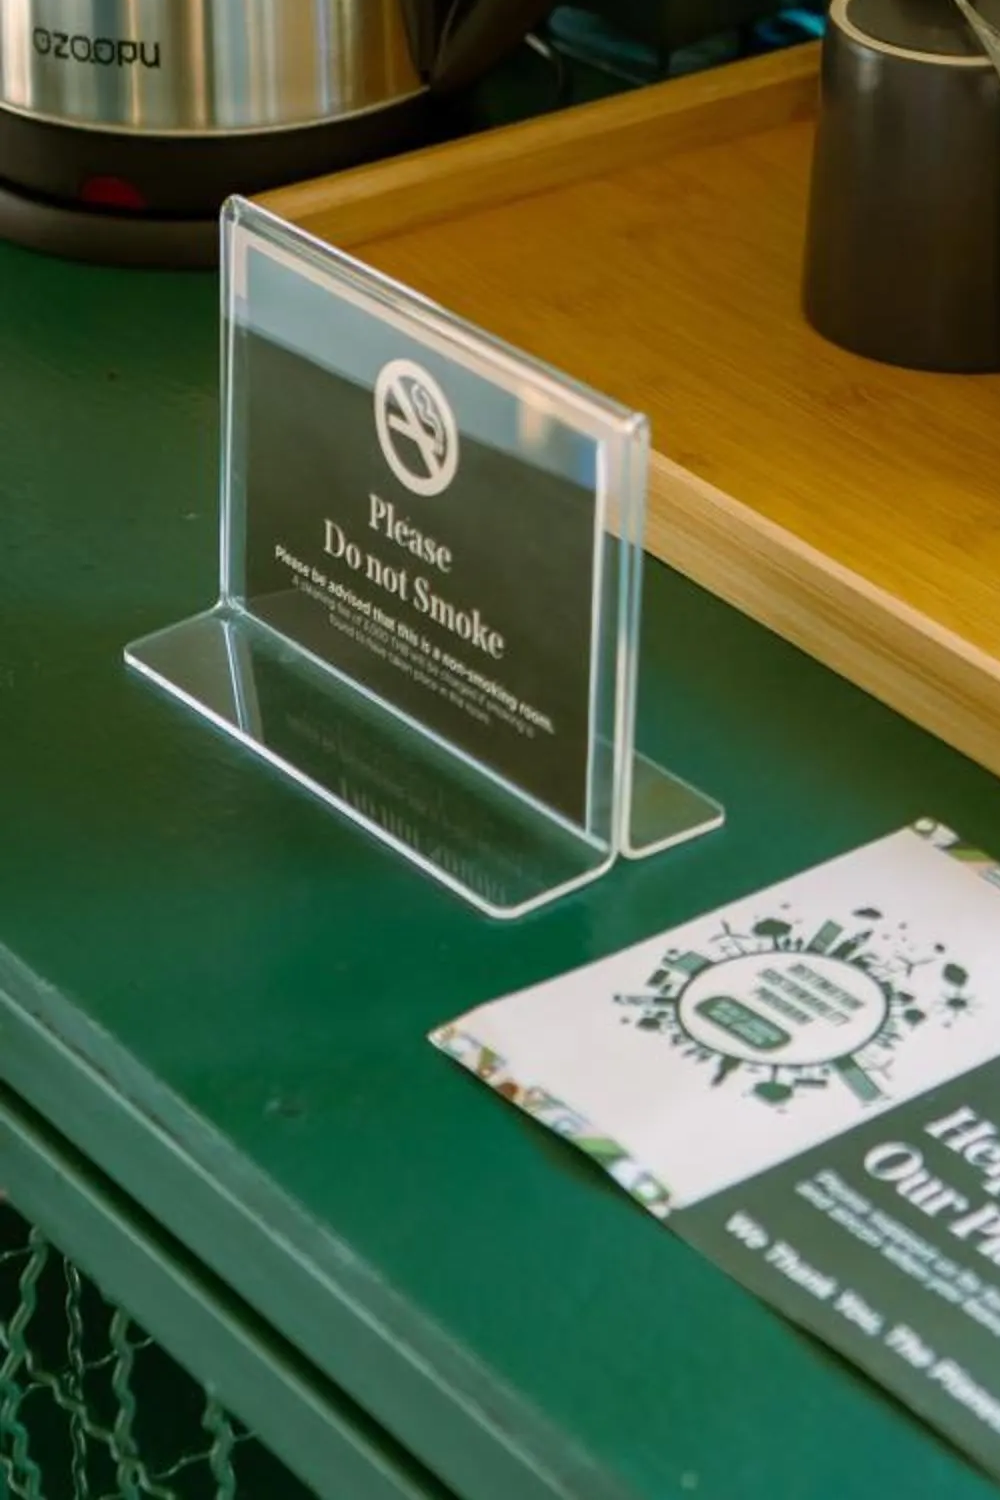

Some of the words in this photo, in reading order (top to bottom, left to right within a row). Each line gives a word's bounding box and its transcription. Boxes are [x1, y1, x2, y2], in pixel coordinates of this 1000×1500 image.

[368, 492, 453, 573] Please
[274, 544, 311, 577] Please
[311, 566, 327, 587] be
[327, 581, 371, 616] advised
[373, 606, 396, 631] that
[397, 621, 418, 647] this
[442, 653, 518, 713] non-smoking
[323, 519, 361, 571] Do
[365, 553, 409, 601] not
[413, 575, 505, 660] Smoke
[864, 1142, 969, 1218] Our
